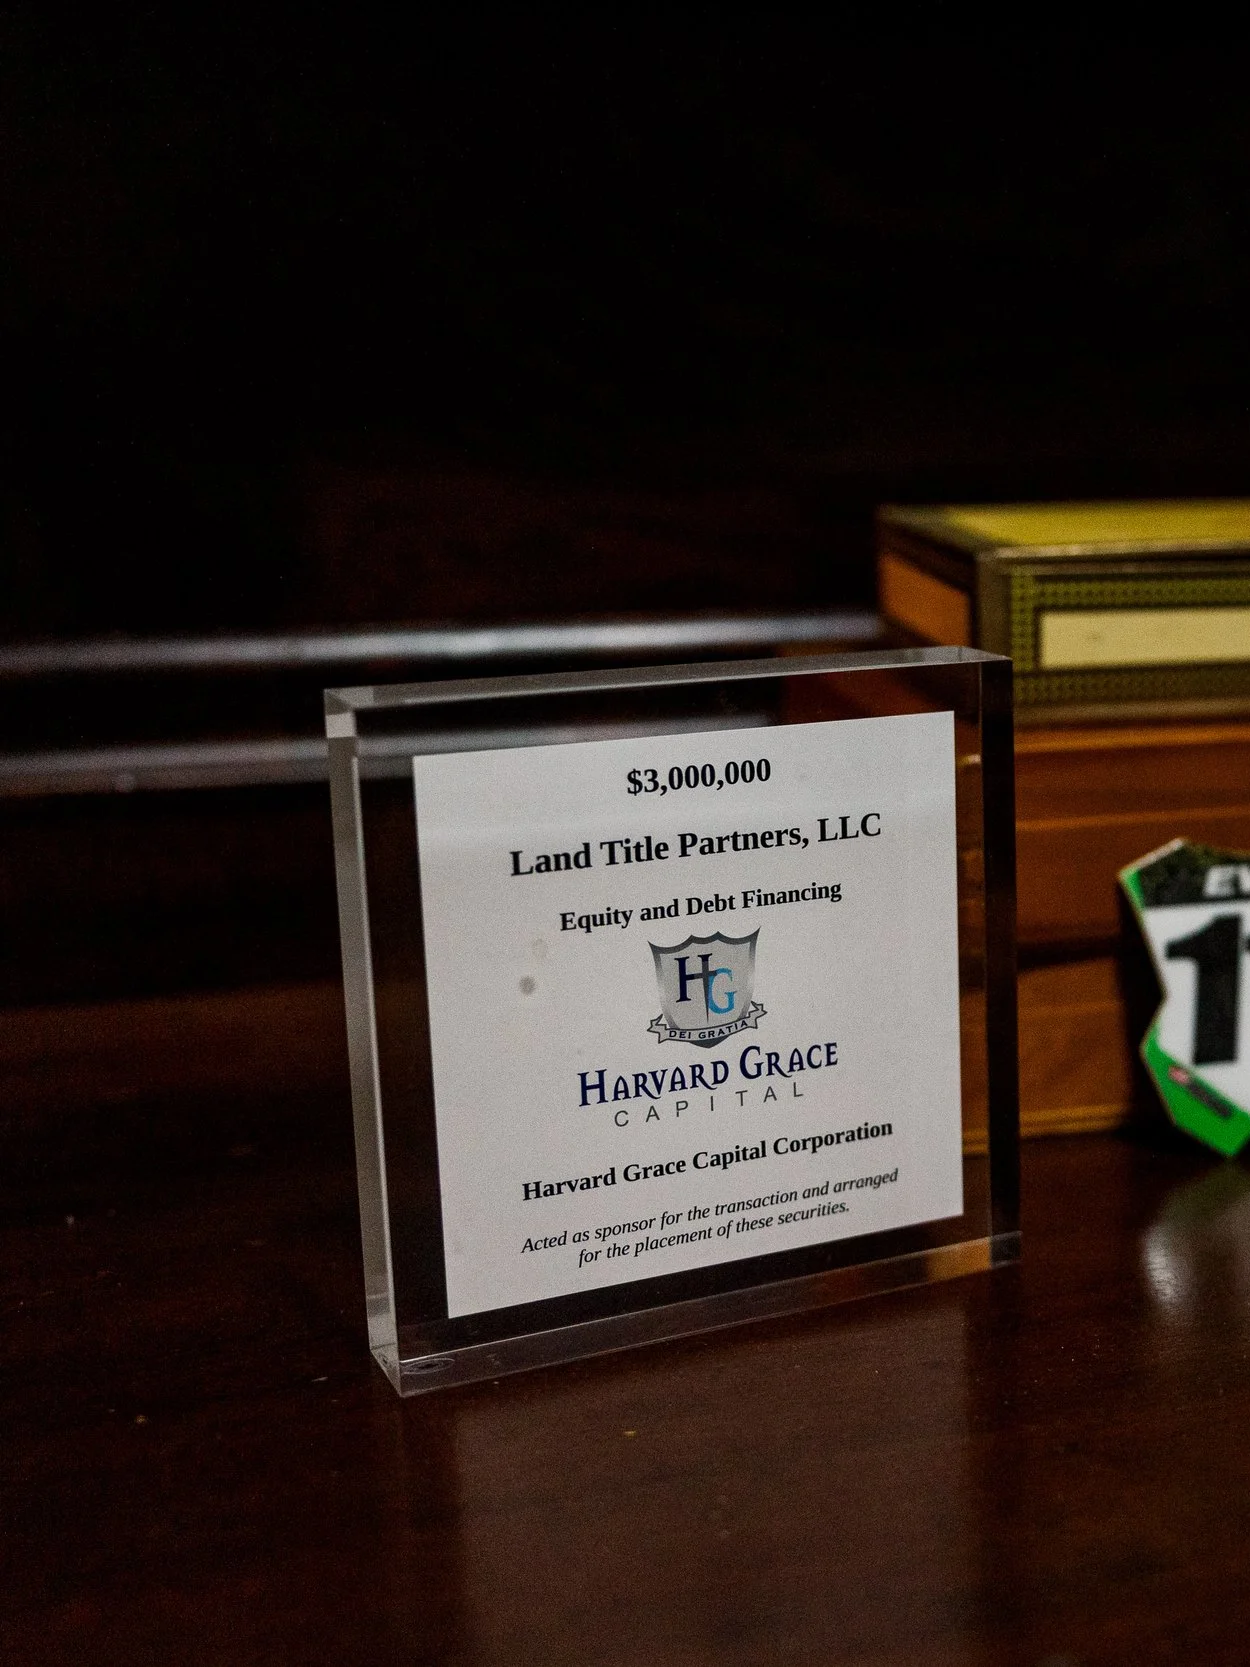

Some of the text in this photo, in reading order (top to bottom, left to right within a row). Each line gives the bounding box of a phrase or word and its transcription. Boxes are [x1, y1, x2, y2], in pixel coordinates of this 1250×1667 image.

[627, 758, 771, 797] $3,000,000
[510, 812, 882, 877] Land Title Partners, LLC
[559, 881, 842, 933] Equity and Debt Financing
[668, 1019, 749, 1040] DEI GRATIA
[577, 1042, 839, 1107] HARVARD GRACE
[614, 1082, 803, 1127] CAPITAL
[522, 1120, 893, 1201] Harvard Grace Capital Corporation
[521, 1168, 898, 1253] Acted as sponsor for the transaction and arranged
[578, 1200, 849, 1268] for the placement of these securities.
